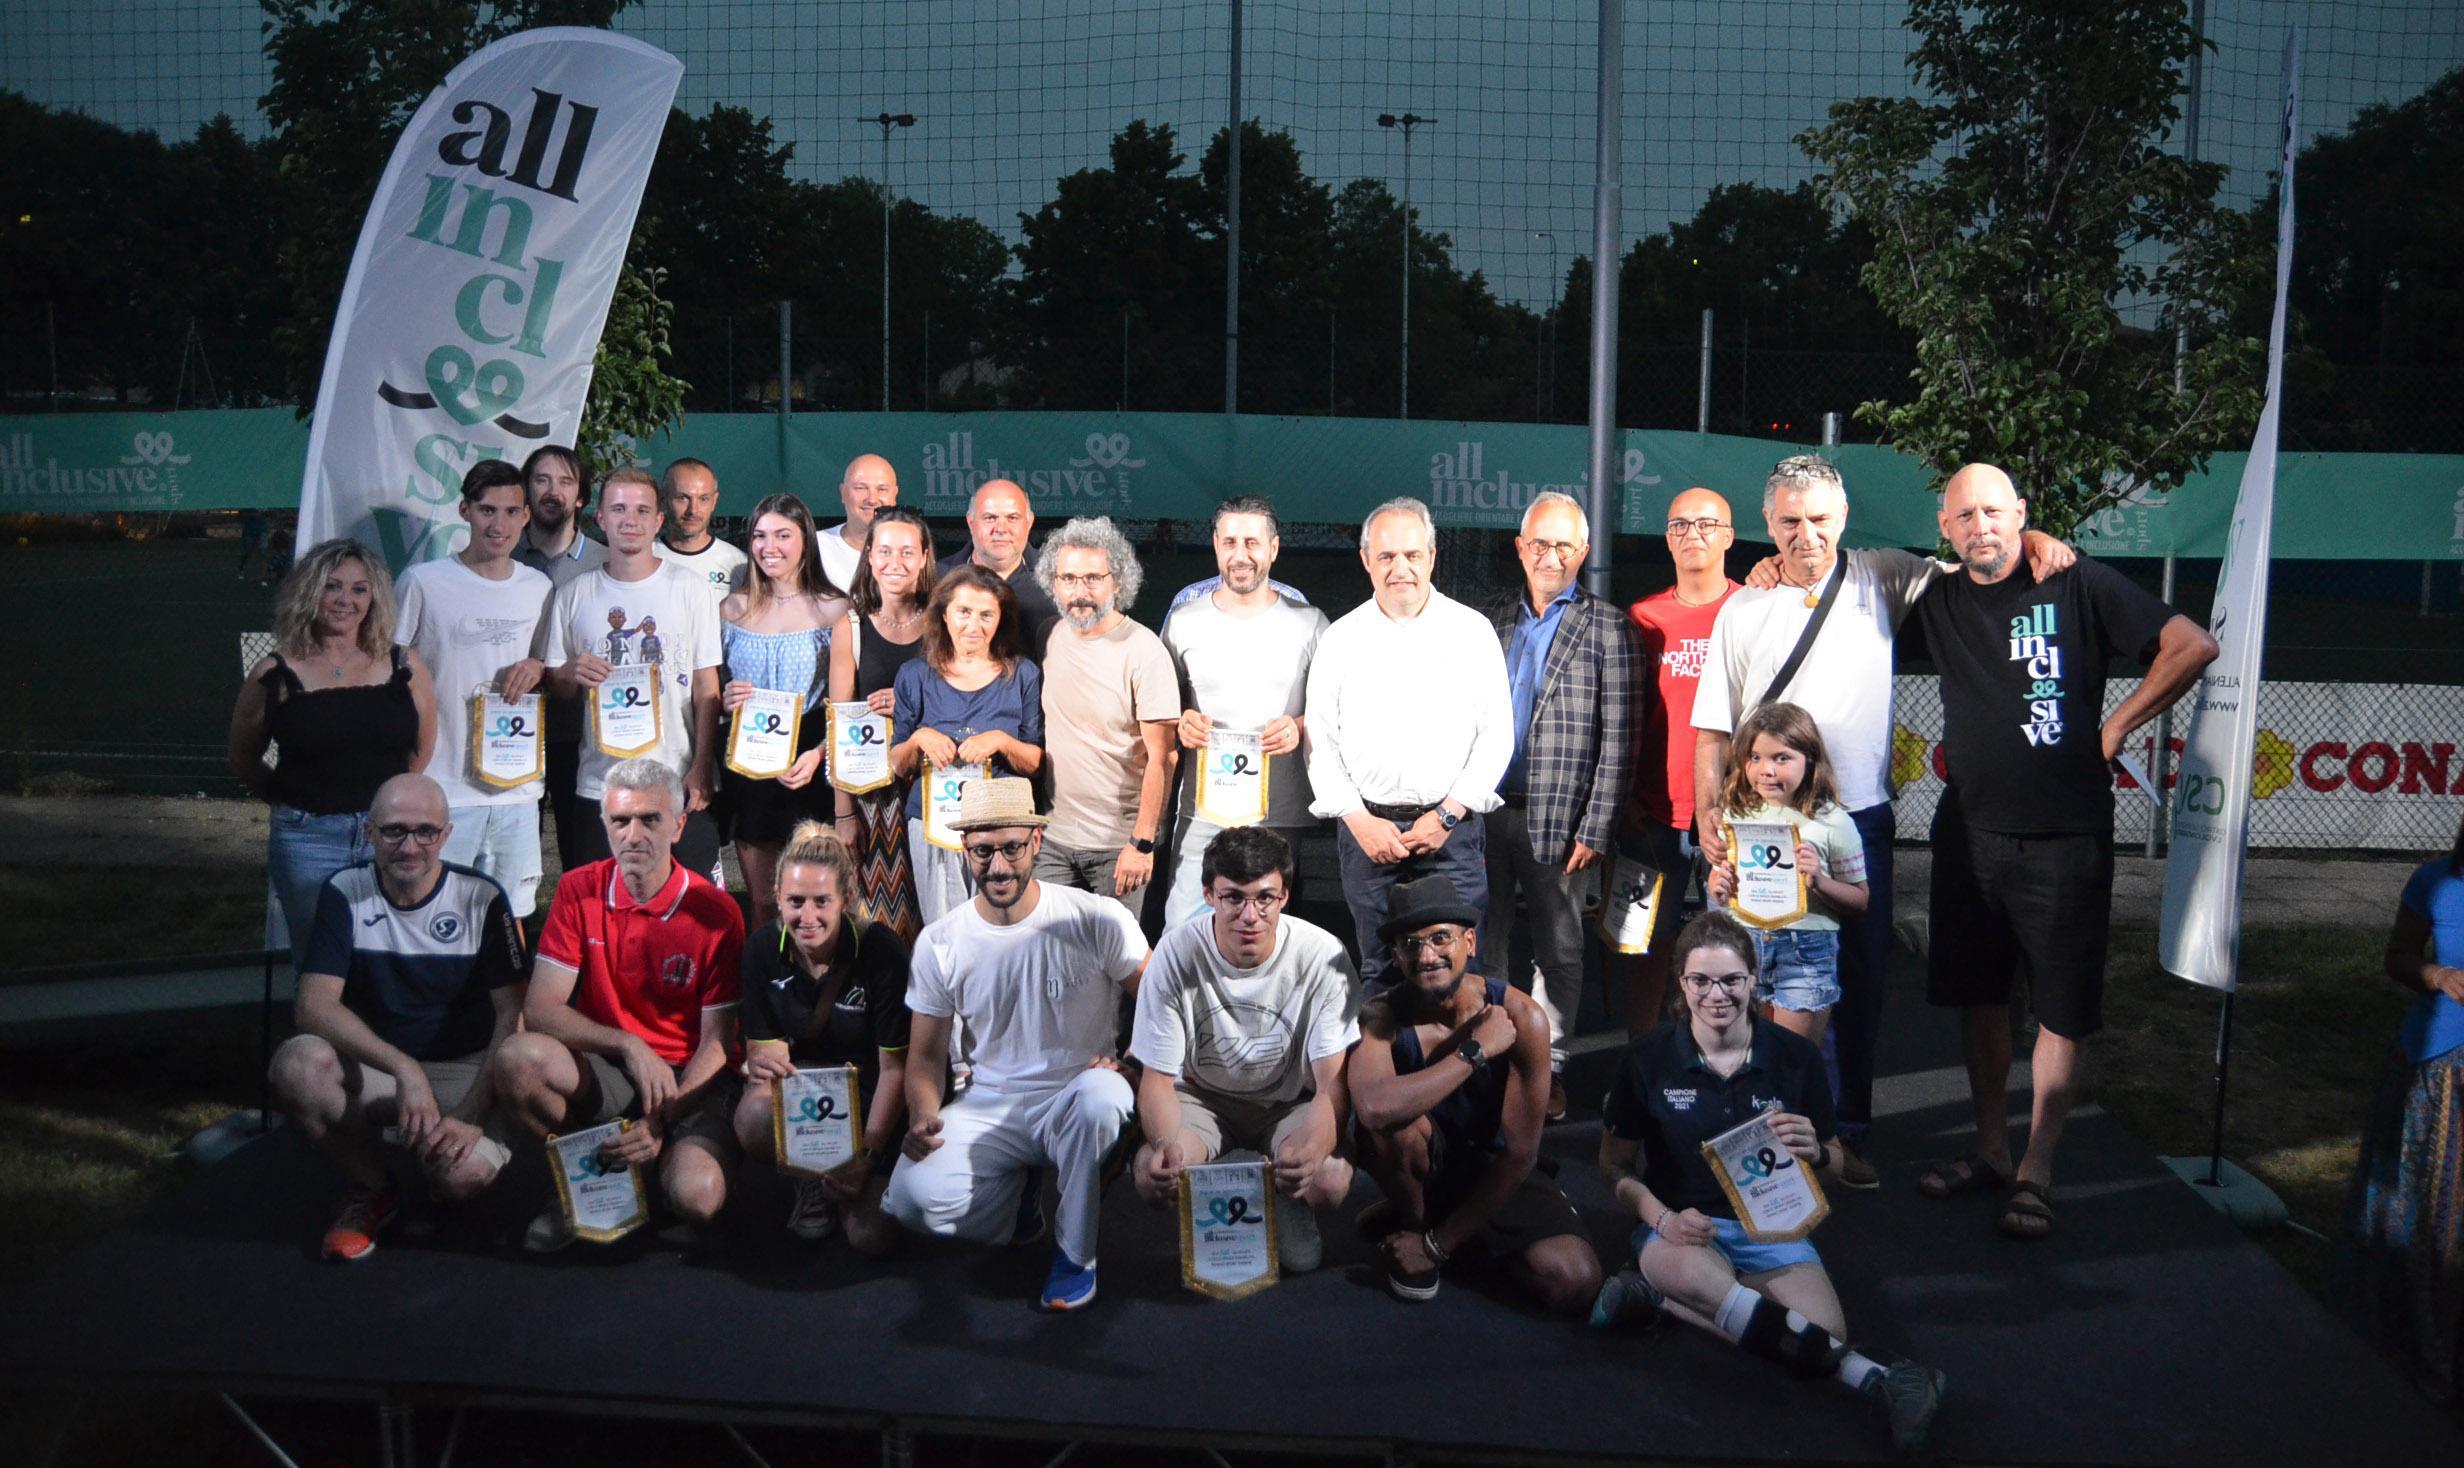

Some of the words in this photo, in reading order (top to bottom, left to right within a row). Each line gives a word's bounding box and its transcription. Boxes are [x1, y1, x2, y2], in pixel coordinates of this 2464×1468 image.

[438, 86, 599, 203] all
[455, 257, 564, 358] cl
[922, 432, 976, 470] all
[1430, 442, 1484, 480] all
[2010, 603, 2057, 638] all
[1680, 639, 1710, 652] THE
[2027, 646, 2061, 679] cl
[1671, 663, 1703, 678] FAC
[2300, 741, 2464, 795] CON
[1663, 1088, 1697, 1096] CAMPIONE
[1667, 1095, 1696, 1103] ITALIANO
